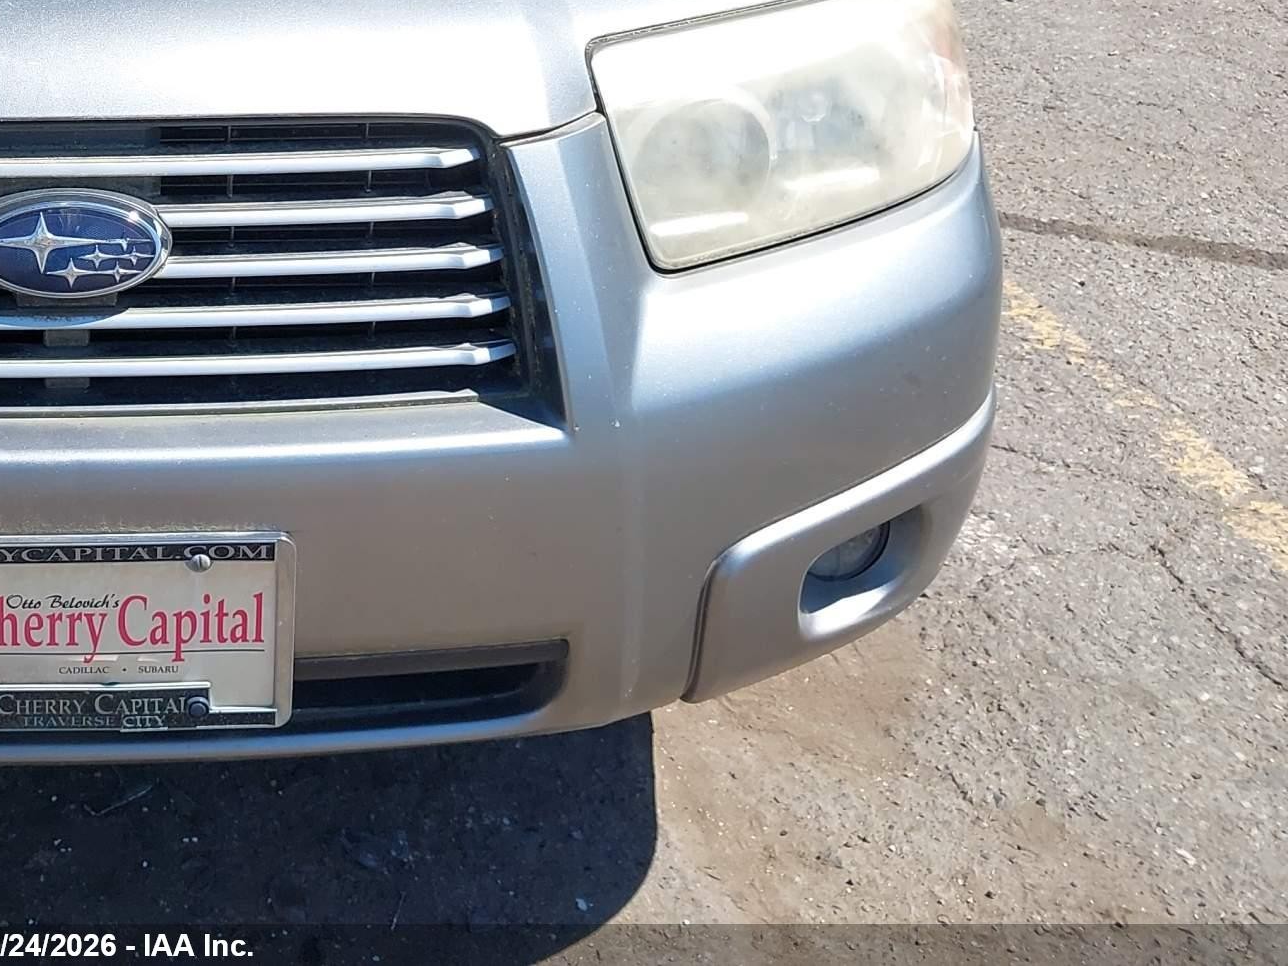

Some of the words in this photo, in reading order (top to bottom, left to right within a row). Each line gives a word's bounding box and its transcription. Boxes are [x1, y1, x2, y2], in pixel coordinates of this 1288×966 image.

[6, 594, 42, 610] Otto
[45, 593, 120, 610] Belovich's
[117, 591, 265, 662] Capital
[58, 665, 110, 675] CADILLAC
[137, 665, 180, 674] SUBARU
[23, 714, 114, 728] TRAVERSE
[122, 715, 167, 728] CITY
